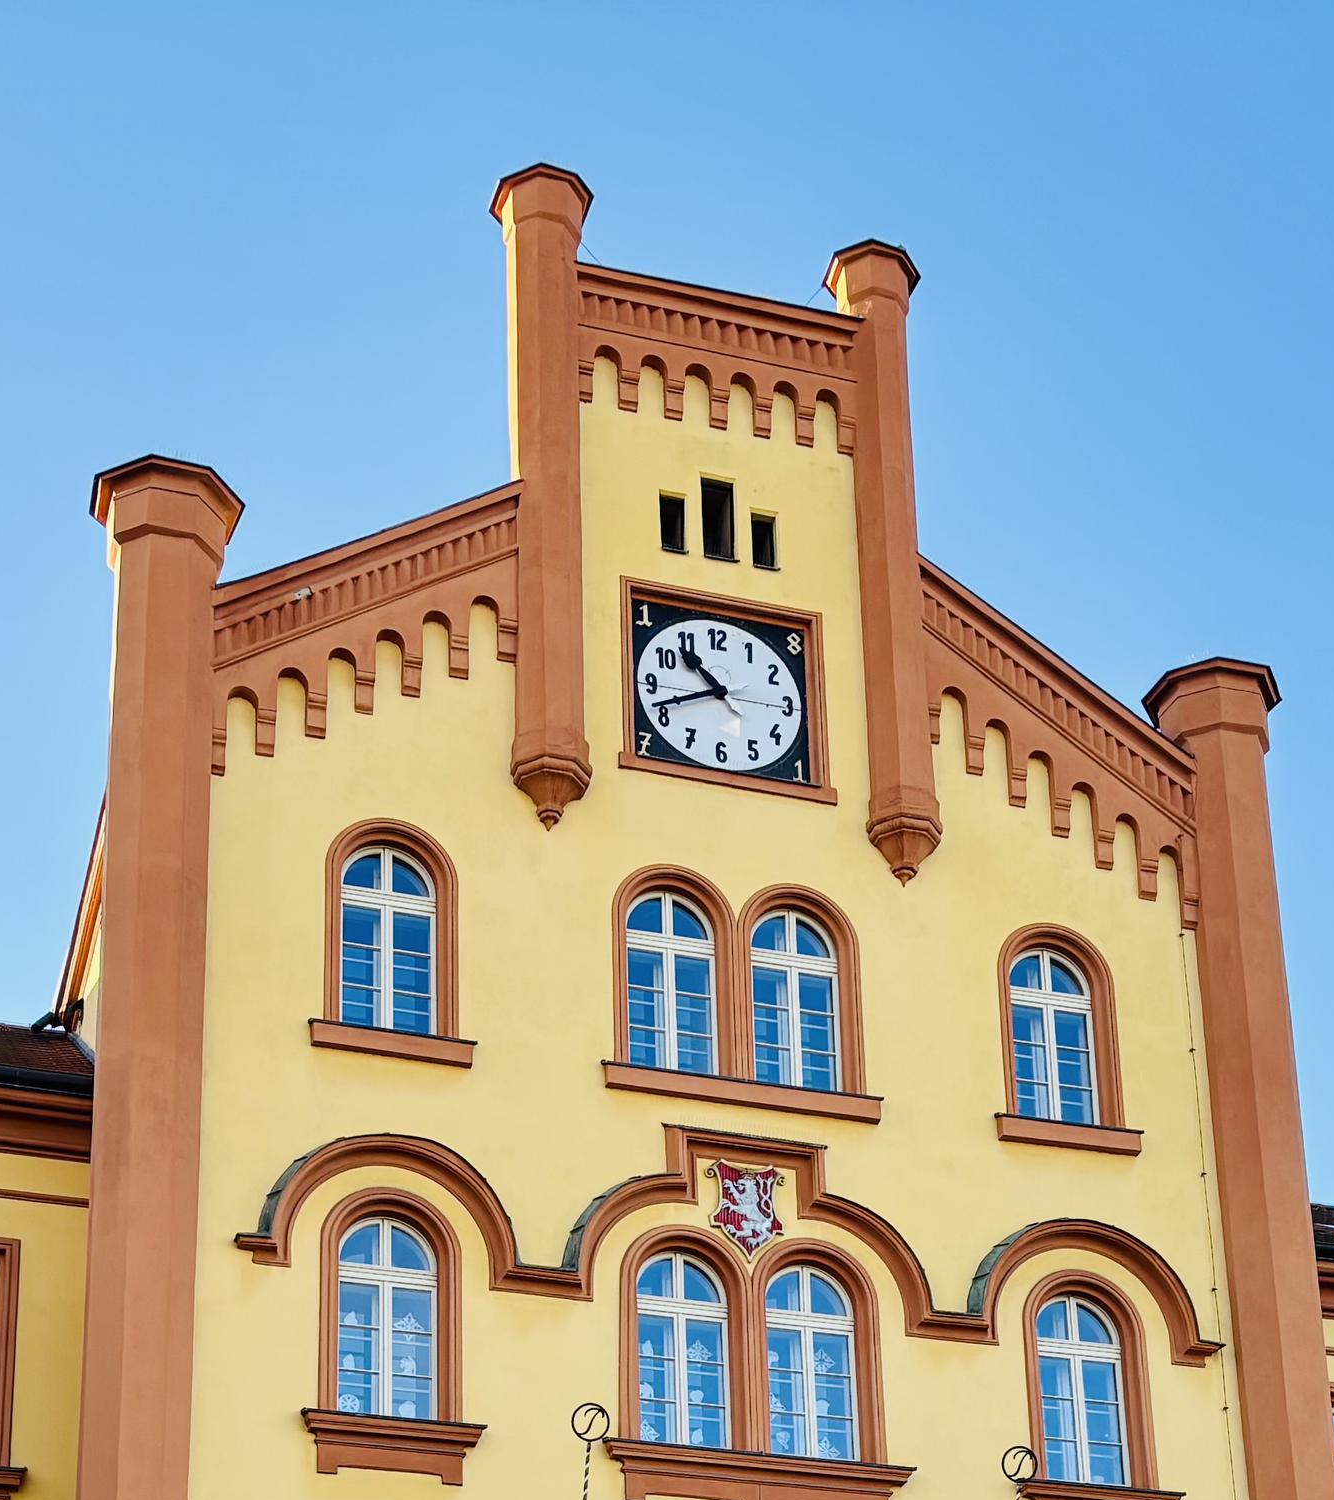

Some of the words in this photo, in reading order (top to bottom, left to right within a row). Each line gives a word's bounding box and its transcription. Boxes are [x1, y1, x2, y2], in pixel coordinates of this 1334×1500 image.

[635, 604, 653, 627] 1
[677, 631, 695, 655] 11
[707, 628, 727, 651] 12
[786, 633, 802, 655] 8
[655, 647, 677, 670] 10
[744, 642, 753, 664] 1
[645, 673, 658, 694] 9
[768, 664, 779, 685] 2
[658, 706, 670, 727] 8
[782, 696, 794, 717] 3
[638, 731, 652, 756] 7
[685, 728, 697, 749] 7
[769, 724, 782, 746] 4
[715, 742, 727, 763] 6
[747, 740, 759, 761] 5
[792, 759, 807, 783] 1
